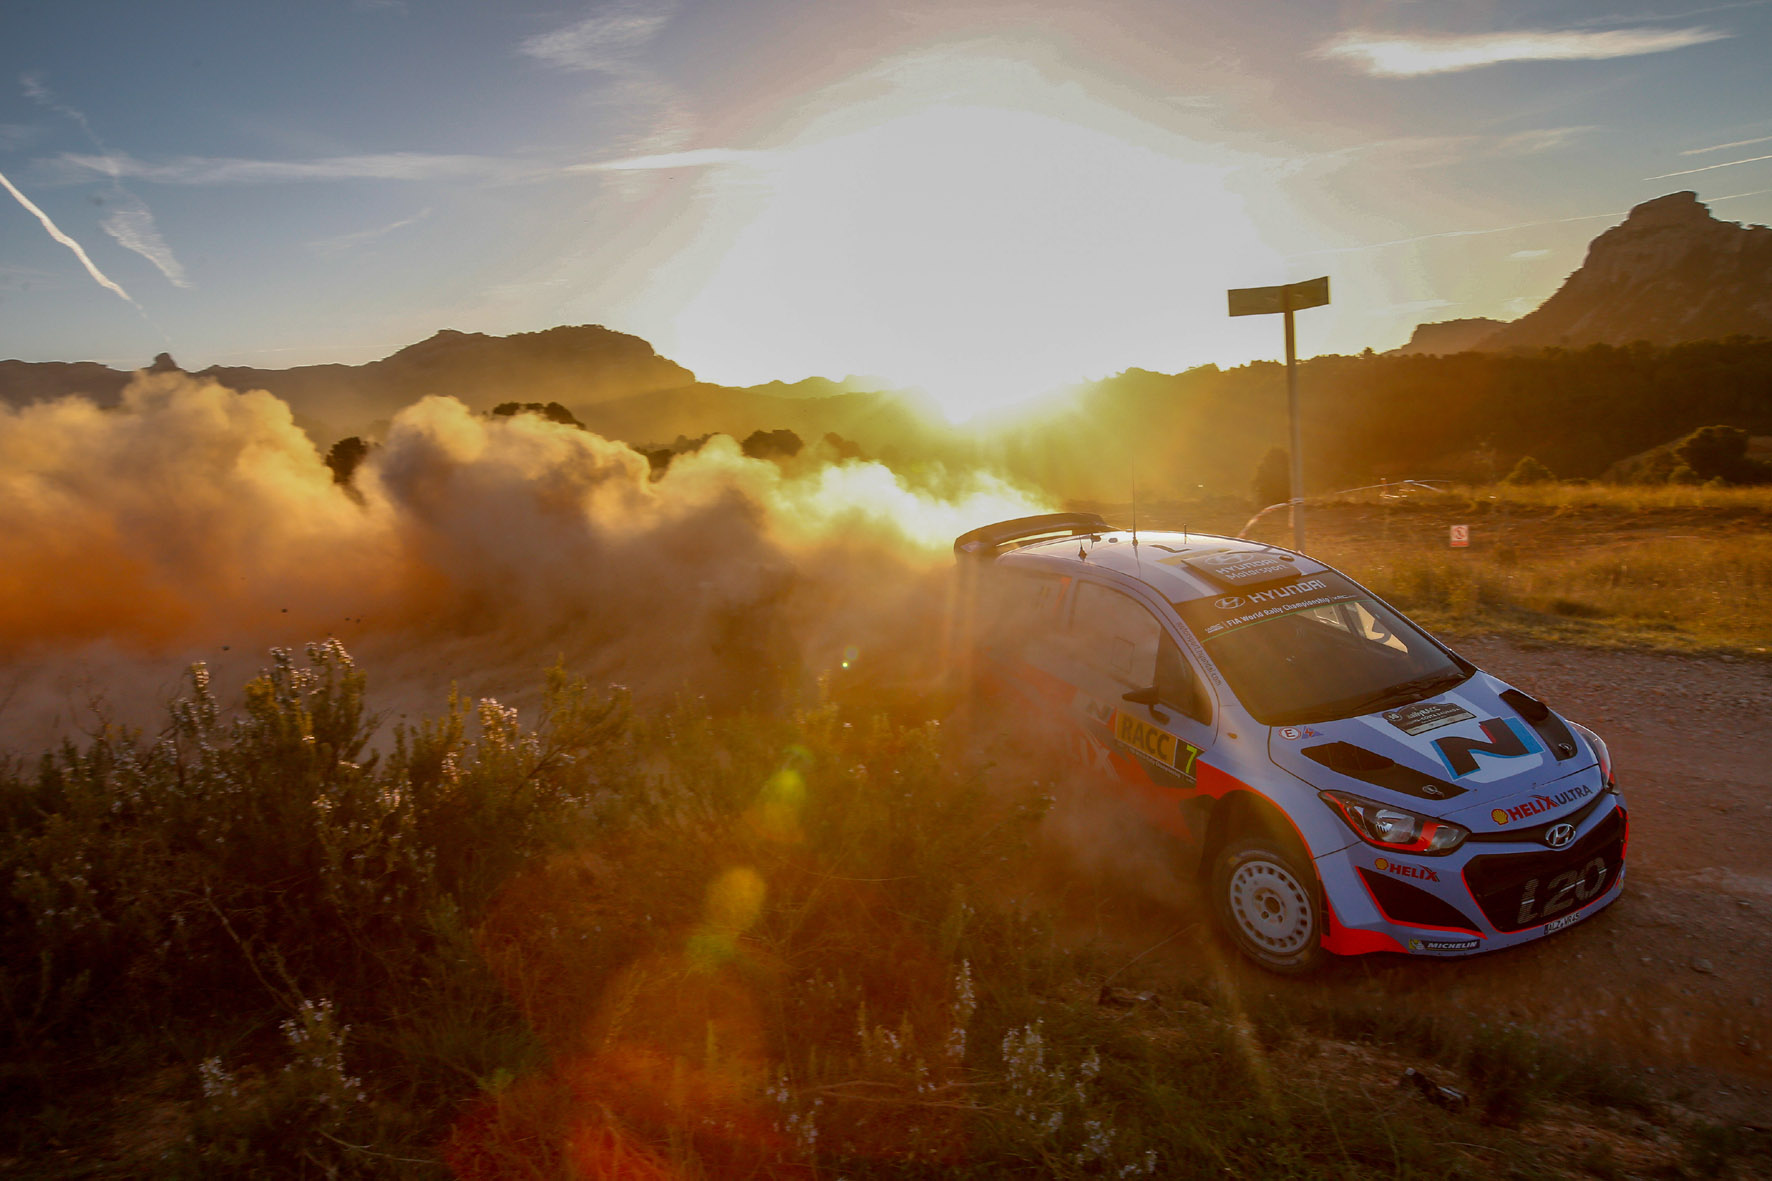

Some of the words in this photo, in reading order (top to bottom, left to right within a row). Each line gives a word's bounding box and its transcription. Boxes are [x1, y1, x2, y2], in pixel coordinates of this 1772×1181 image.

[1216, 558, 1278, 575] HYUNDAI
[1225, 563, 1290, 581] Motorsport
[1248, 579, 1327, 603] HYUNDAI
[1226, 617, 1242, 628] FIA
[1240, 611, 1264, 622] World
[1264, 606, 1283, 617] Rally
[1282, 596, 1331, 611] Championship
[1121, 716, 1170, 761] RACC
[1284, 728, 1295, 739] E
[1186, 744, 1198, 774] 7
[1507, 794, 1559, 822] HELIX
[1555, 784, 1594, 808] ULTRA
[1390, 862, 1440, 883] HELIX
[1427, 941, 1478, 950] MICHELIN
